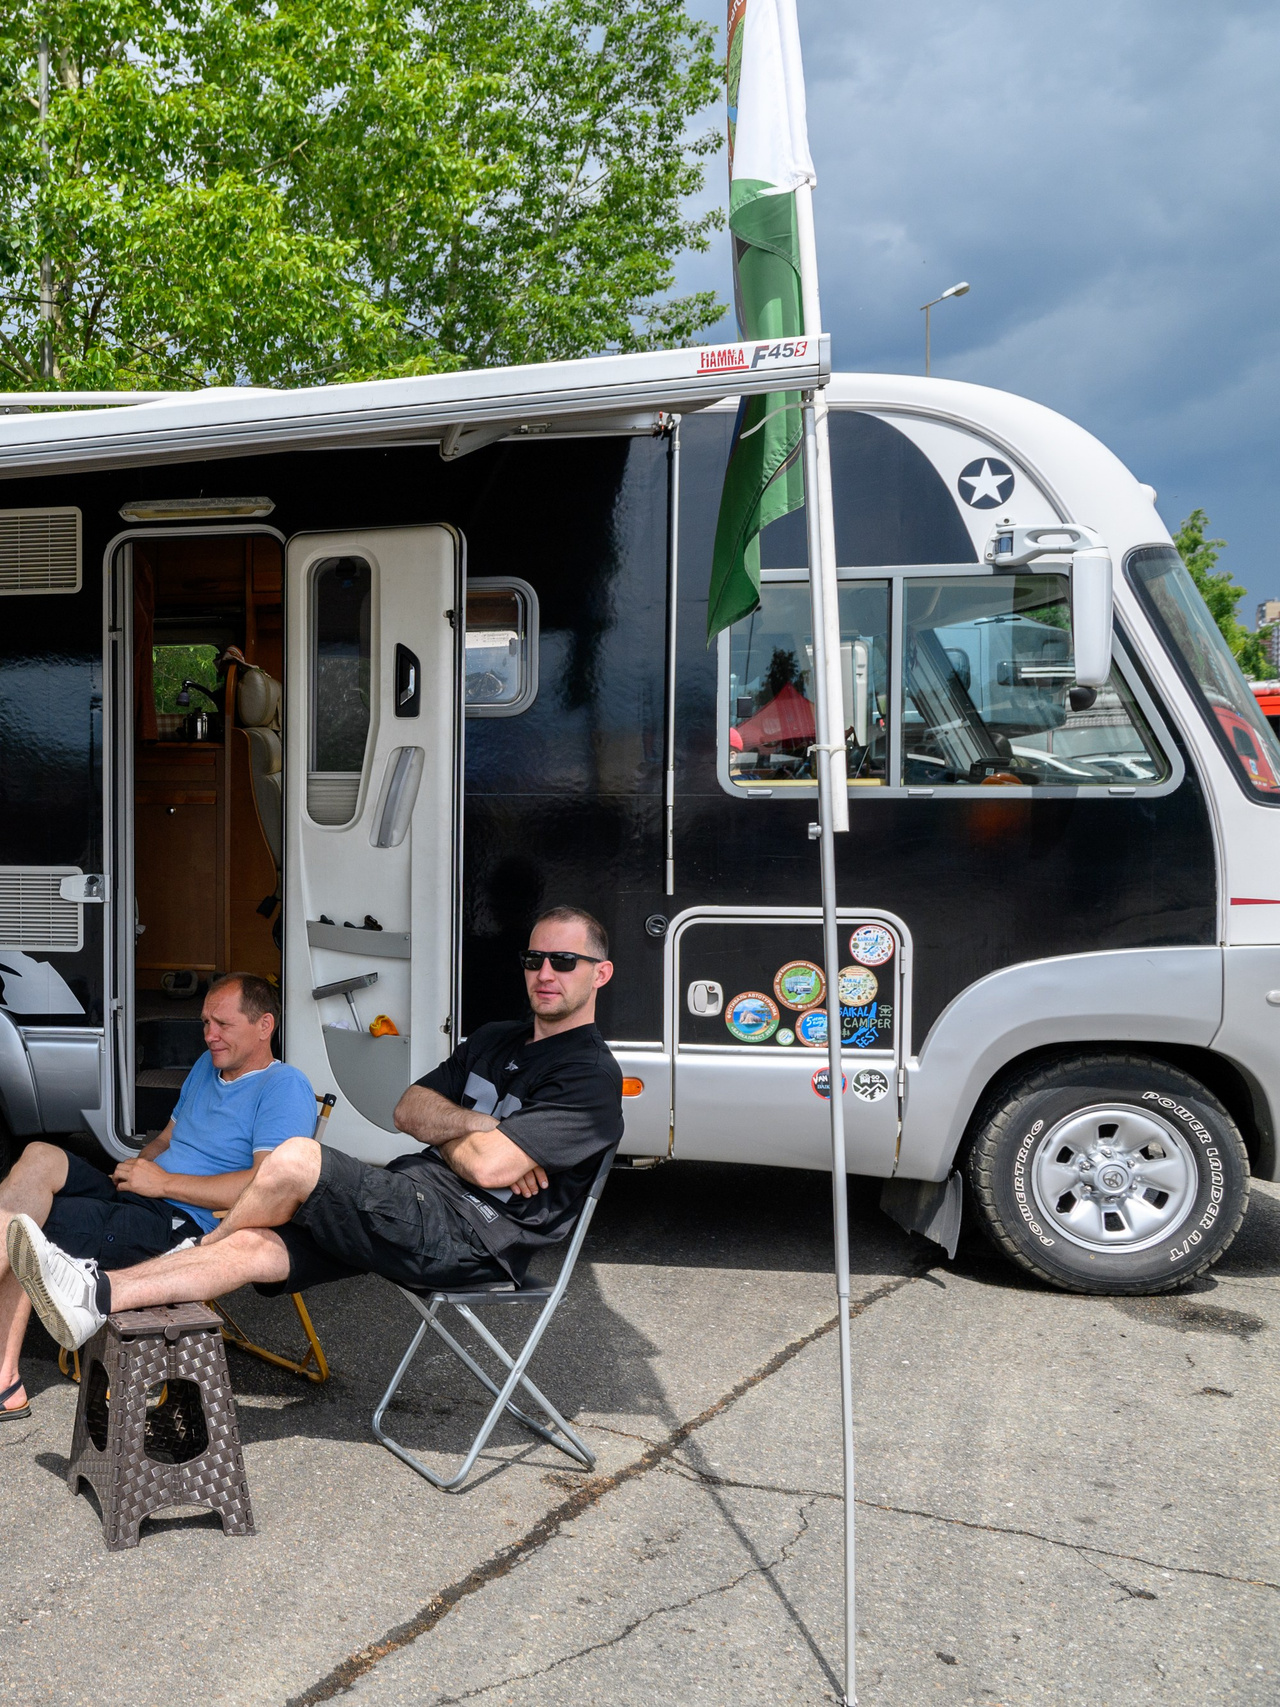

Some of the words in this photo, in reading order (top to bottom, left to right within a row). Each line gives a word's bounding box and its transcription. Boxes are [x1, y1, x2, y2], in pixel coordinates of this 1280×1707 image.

[844, 1018, 891, 1028] CAMPER
[856, 1026, 879, 1048] FEST
[1141, 1091, 1213, 1145] POWER
[1013, 1119, 1056, 1248] POWERTRAC
[1199, 1147, 1224, 1230] LANDER
[1170, 1230, 1203, 1262] A/T
